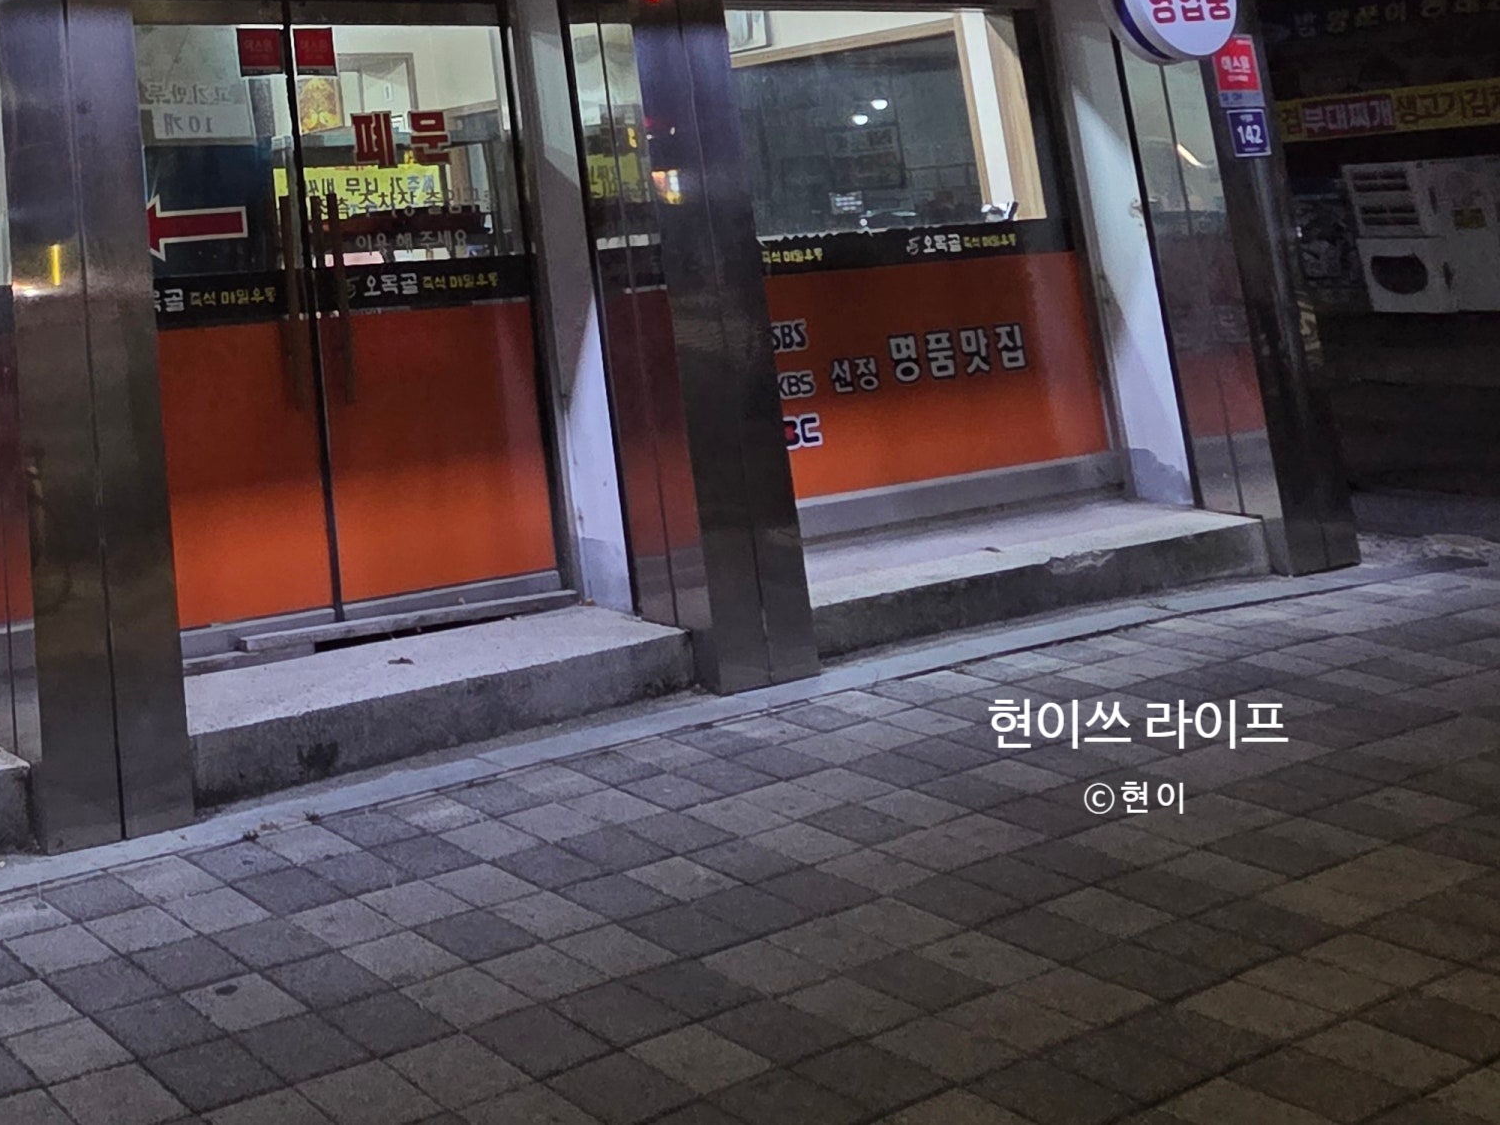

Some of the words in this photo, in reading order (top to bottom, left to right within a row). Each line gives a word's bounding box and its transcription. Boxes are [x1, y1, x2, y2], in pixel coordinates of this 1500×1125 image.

[1237, 124, 1264, 145] 142
[363, 272, 420, 297] 오목골
[831, 357, 879, 393] 선정
[888, 324, 1027, 382] 명품맛집
